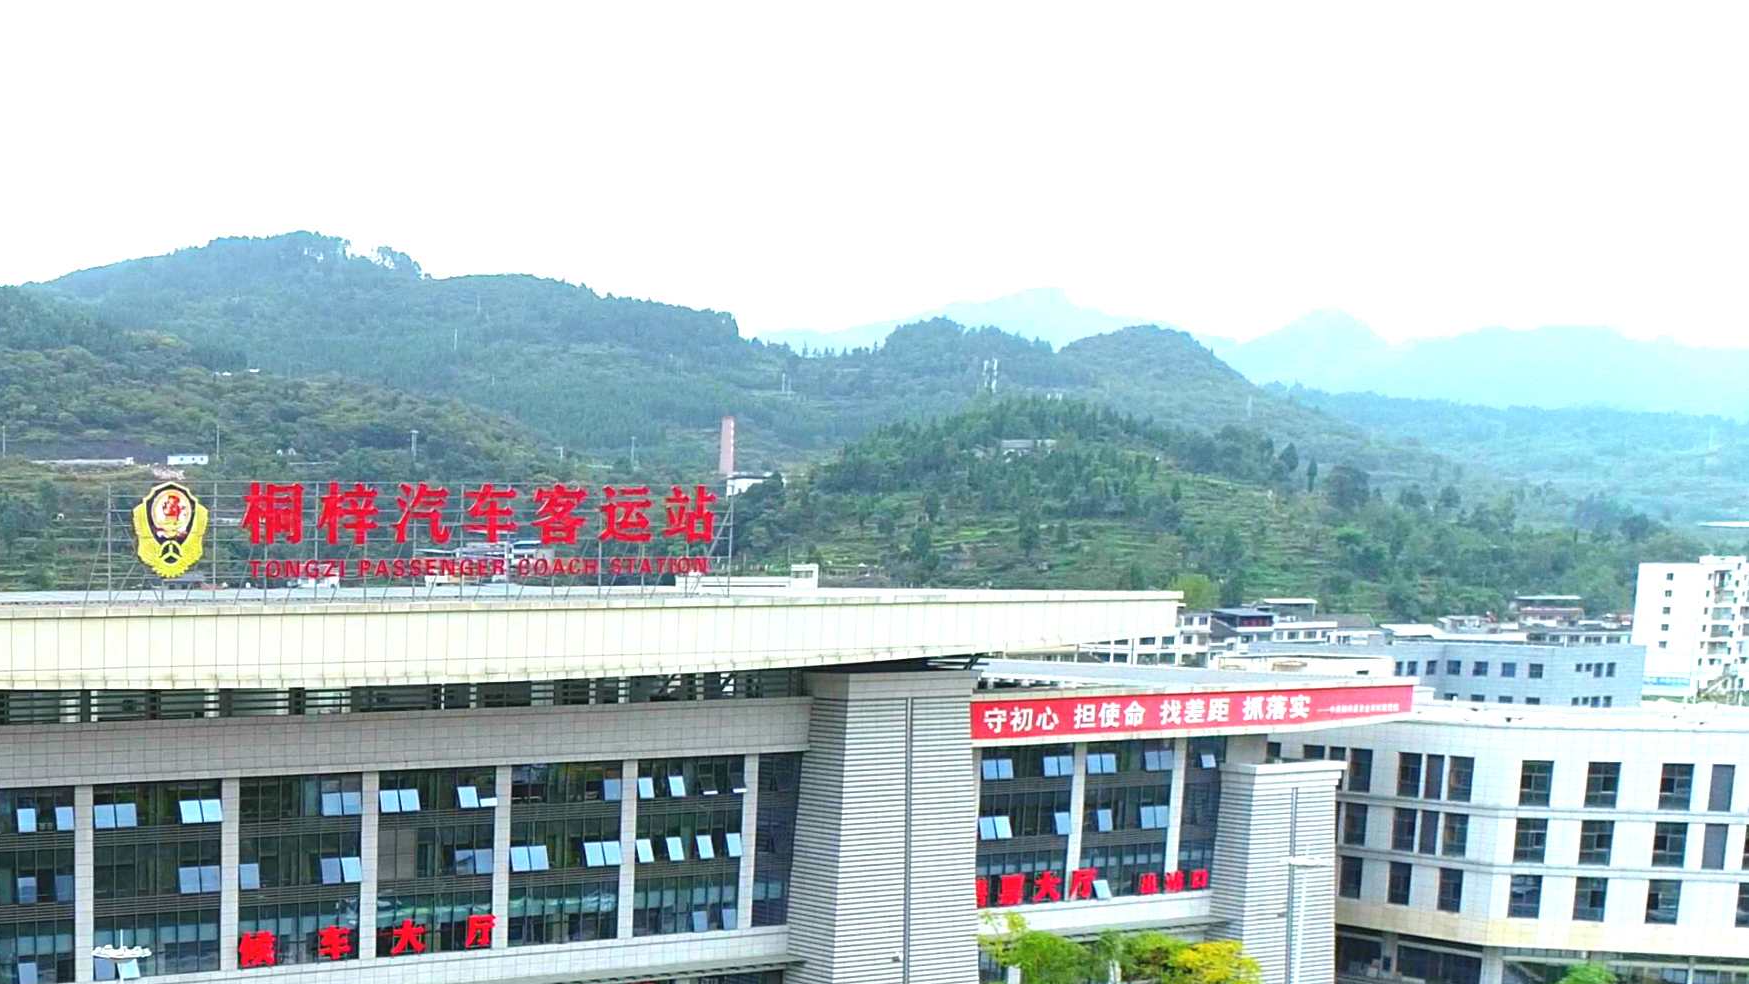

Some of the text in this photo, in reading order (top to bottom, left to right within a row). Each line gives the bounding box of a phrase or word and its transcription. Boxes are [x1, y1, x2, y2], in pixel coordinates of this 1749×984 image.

[240, 481, 717, 545] 桐梓汽车客运站
[250, 556, 709, 578] TONGZI PASSENGER COACH STATION
[983, 694, 1311, 733] 守初心 担使命 找差距 抓落实
[238, 914, 496, 967] 候车大厅
